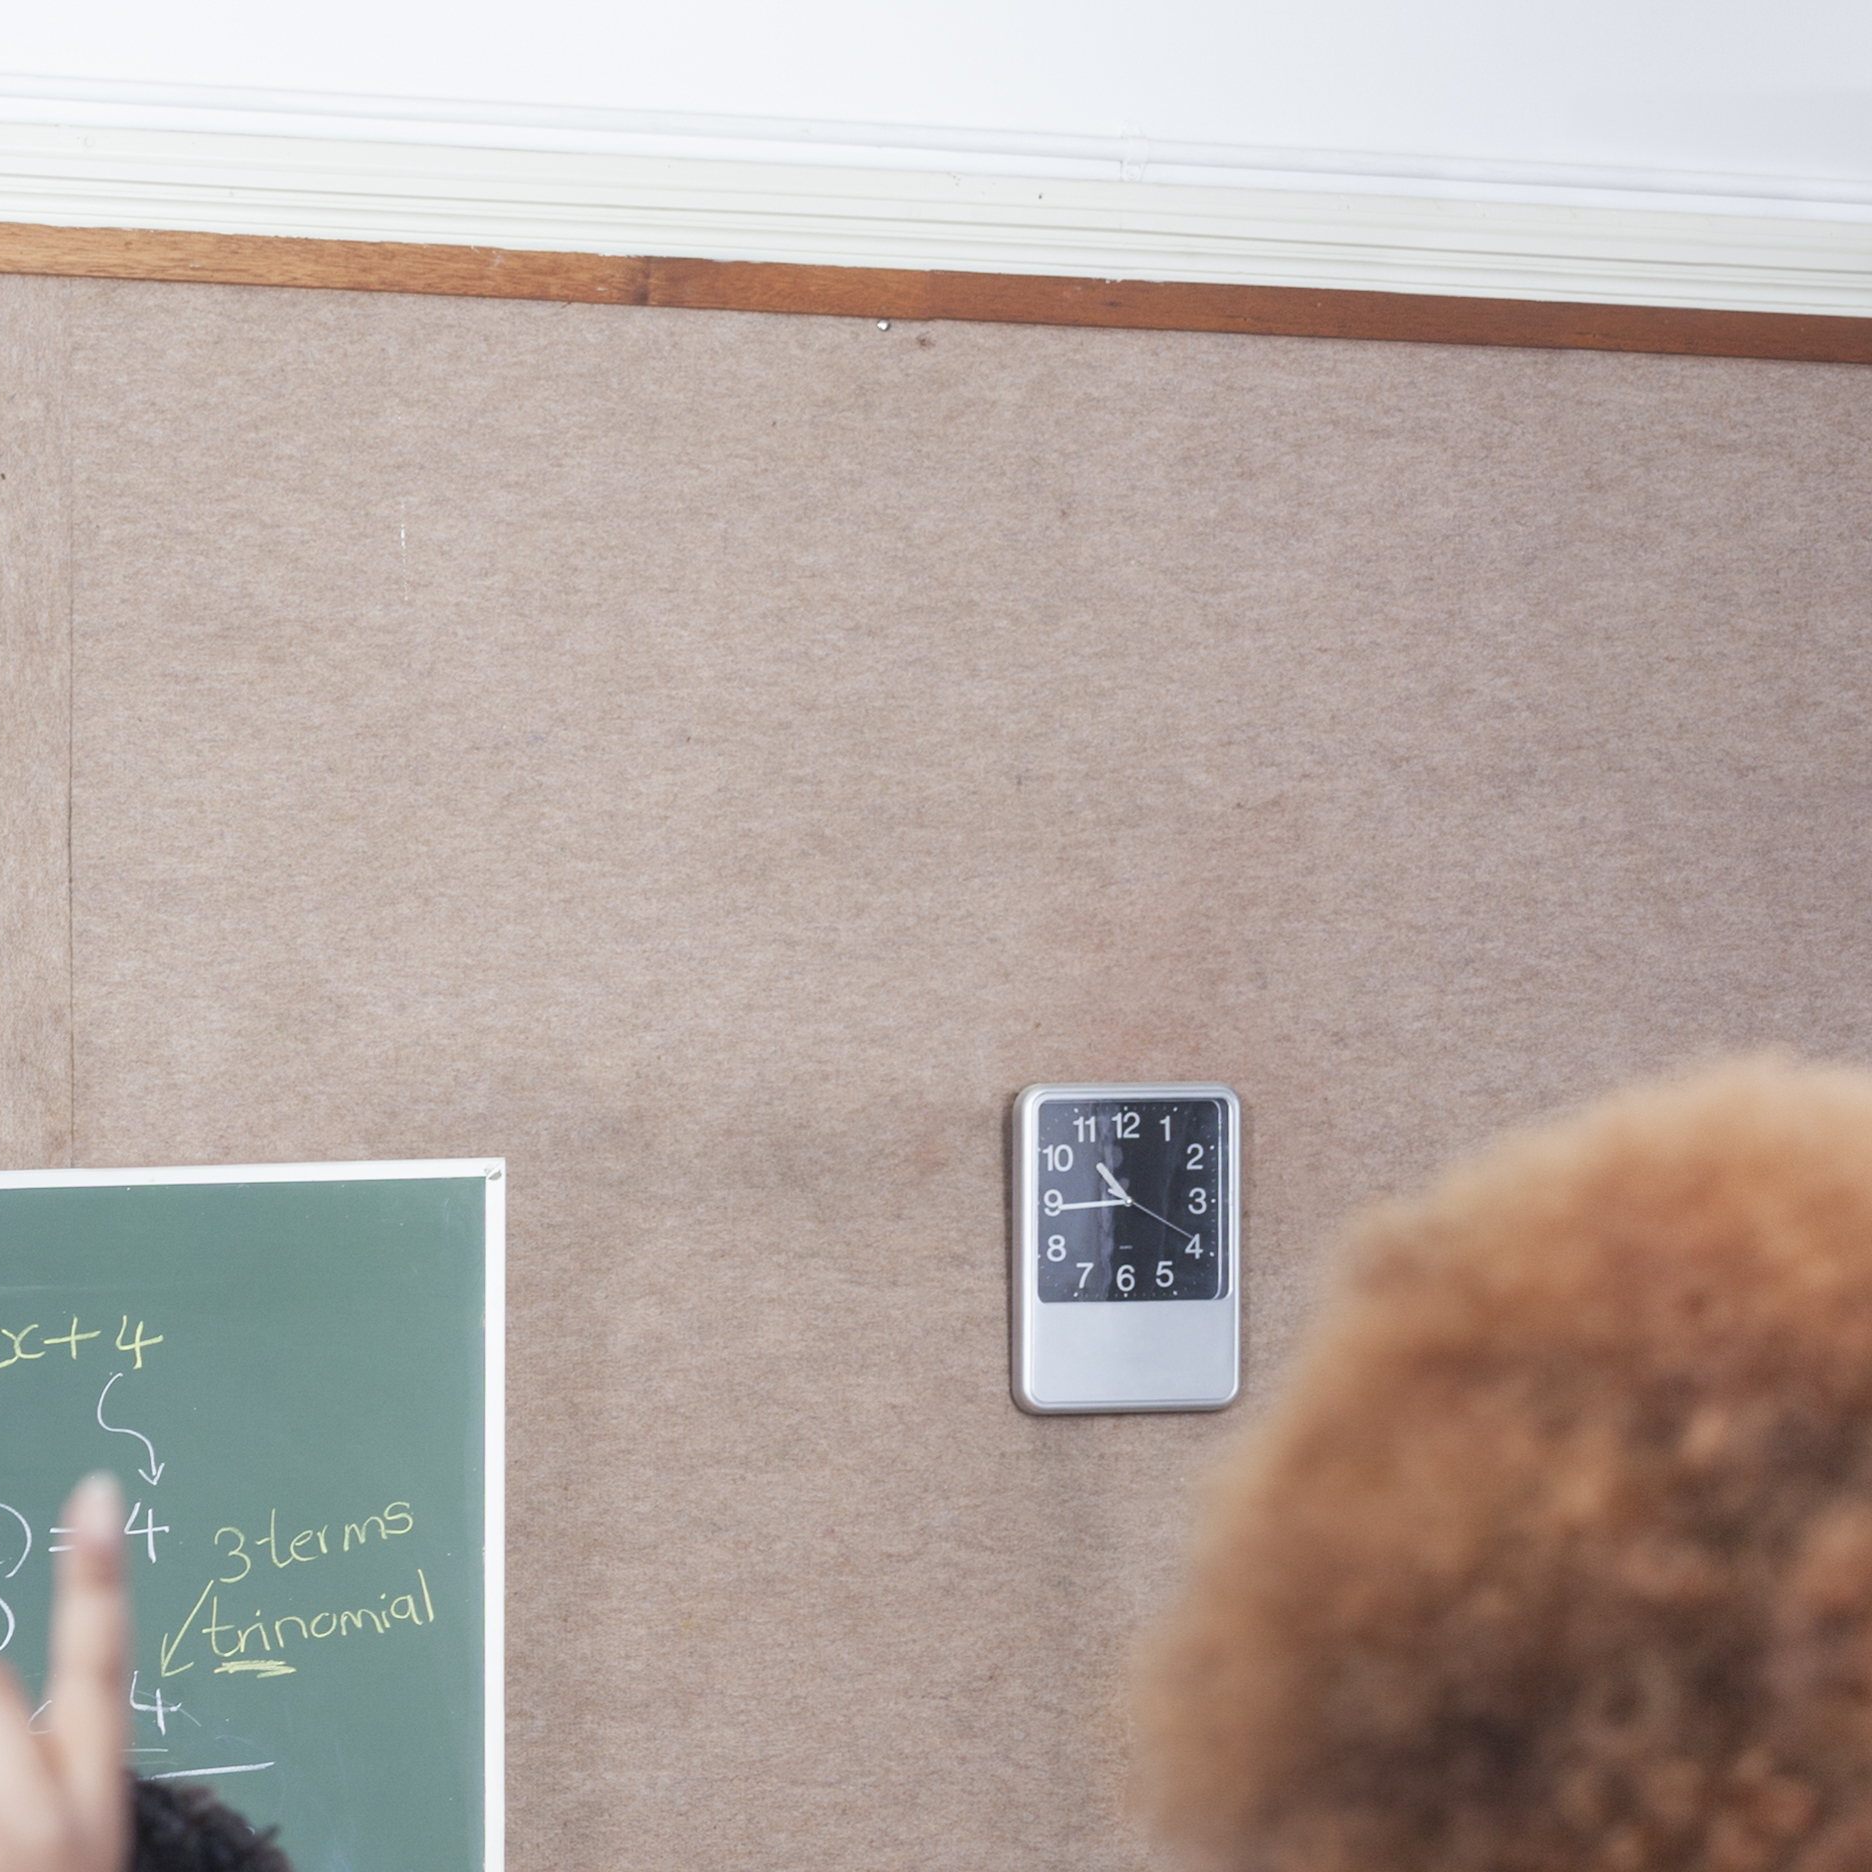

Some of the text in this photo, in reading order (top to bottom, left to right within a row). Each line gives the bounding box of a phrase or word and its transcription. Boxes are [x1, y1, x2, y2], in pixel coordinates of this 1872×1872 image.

[1073, 1116, 1097, 1142] 11
[1111, 1112, 1140, 1139] 12
[1159, 1116, 1171, 1142] 1
[1042, 1144, 1074, 1172] 10
[1186, 1143, 1204, 1171] 2
[1043, 1189, 1064, 1217] 9
[1187, 1188, 1207, 1215] 3
[1046, 1235, 1067, 1262] 8
[1184, 1234, 1204, 1259] 4
[1075, 1262, 1094, 1289] 7
[1115, 1265, 1136, 1292] 6
[1155, 1260, 1175, 1288] 5
[202, 1567, 435, 1658] trinomial
